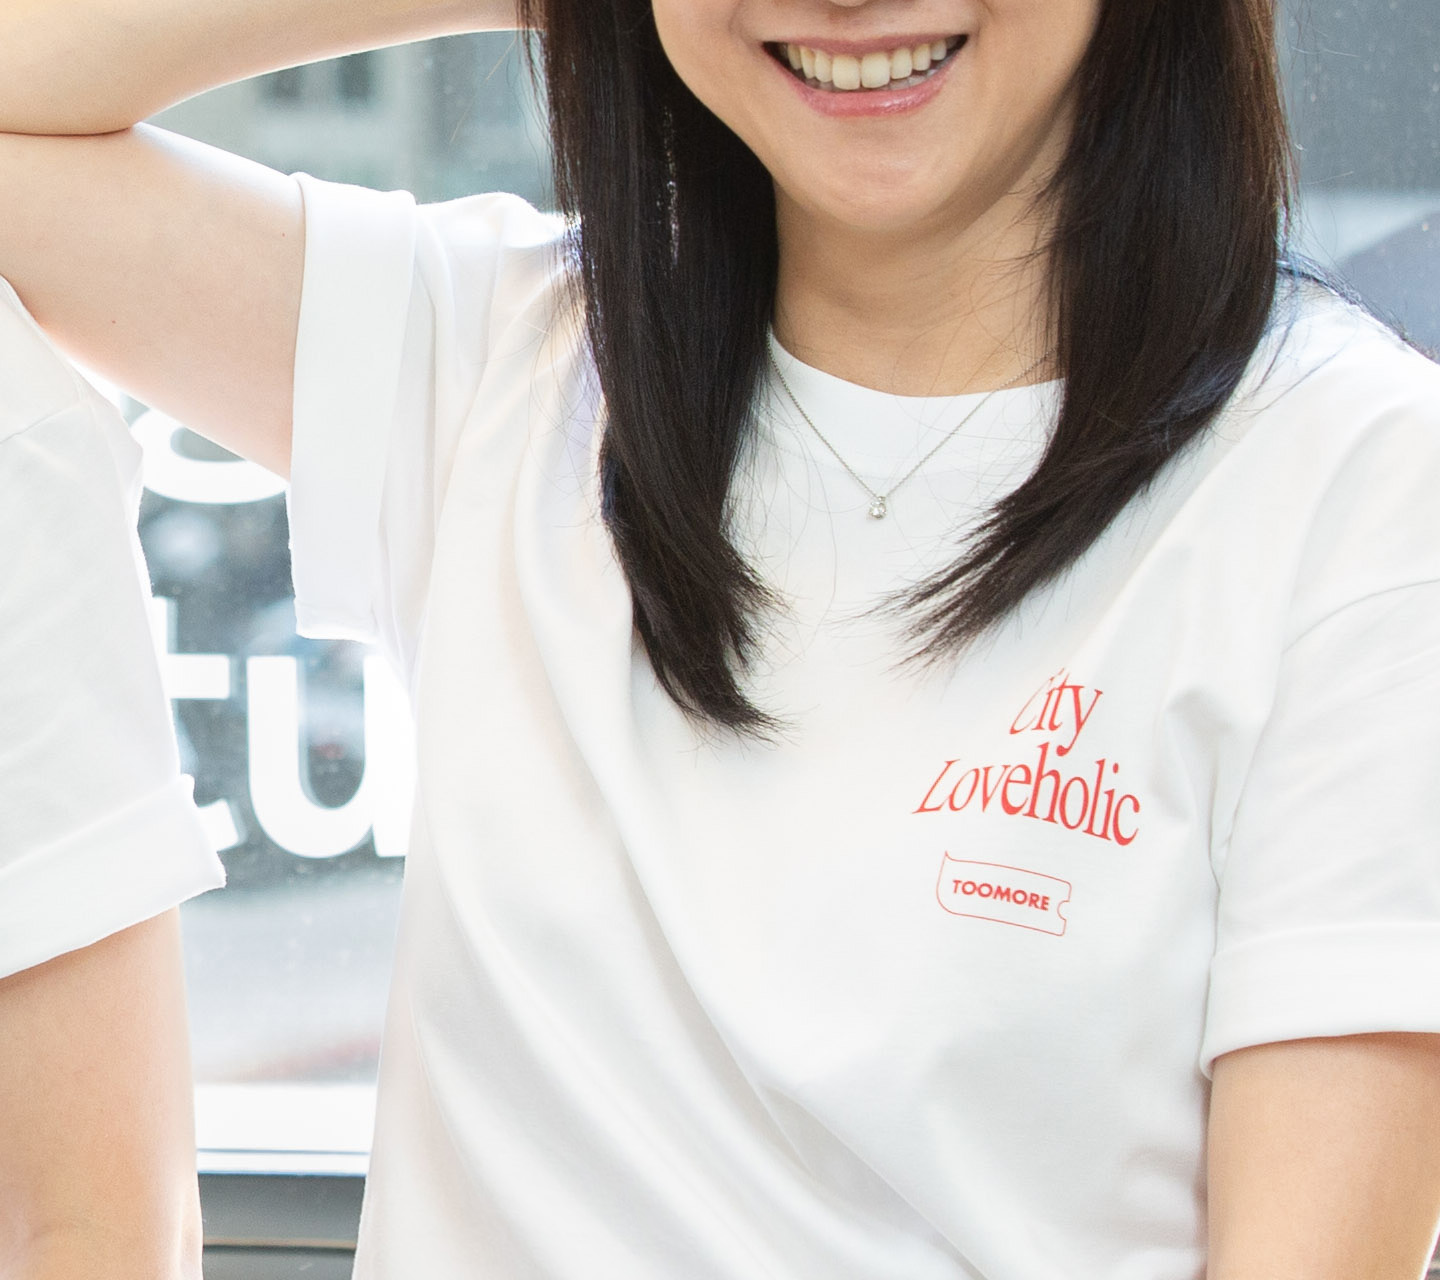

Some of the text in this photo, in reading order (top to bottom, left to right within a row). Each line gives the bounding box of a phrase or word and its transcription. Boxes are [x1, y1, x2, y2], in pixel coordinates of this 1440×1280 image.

[1009, 668, 1103, 756] City
[912, 741, 1140, 846] Loveholic
[952, 878, 1049, 911] TOOMORE
